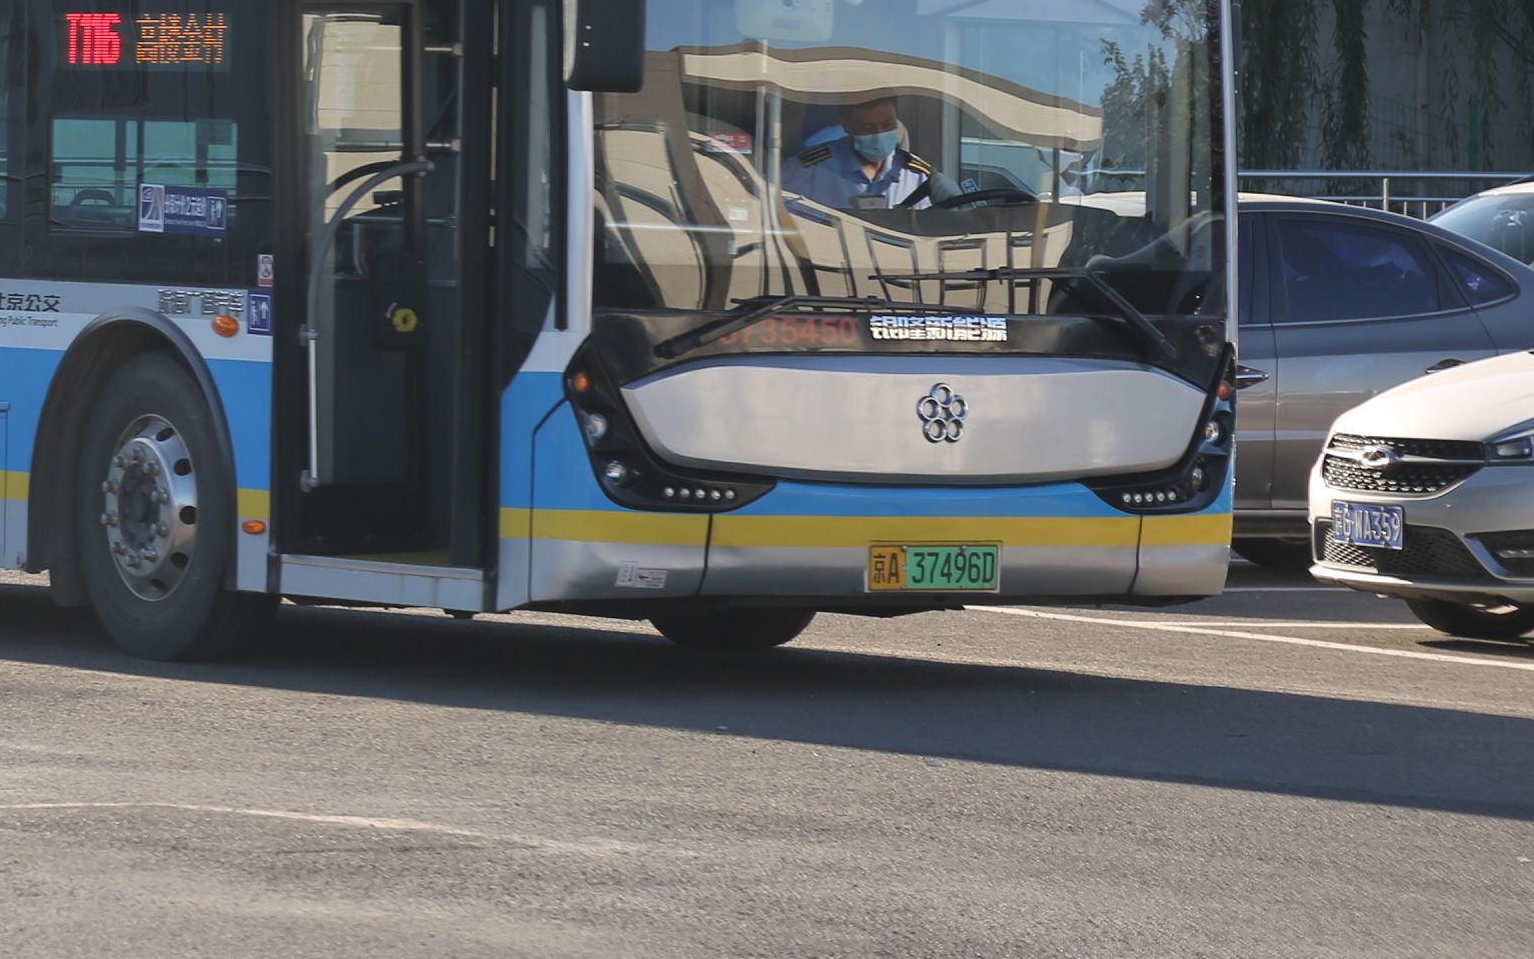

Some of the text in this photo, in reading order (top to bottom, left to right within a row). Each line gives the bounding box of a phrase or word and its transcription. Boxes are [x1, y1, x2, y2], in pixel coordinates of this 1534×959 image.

[65, 12, 123, 64] T116
[8, 315, 26, 326] Public
[27, 316, 59, 328] Transport
